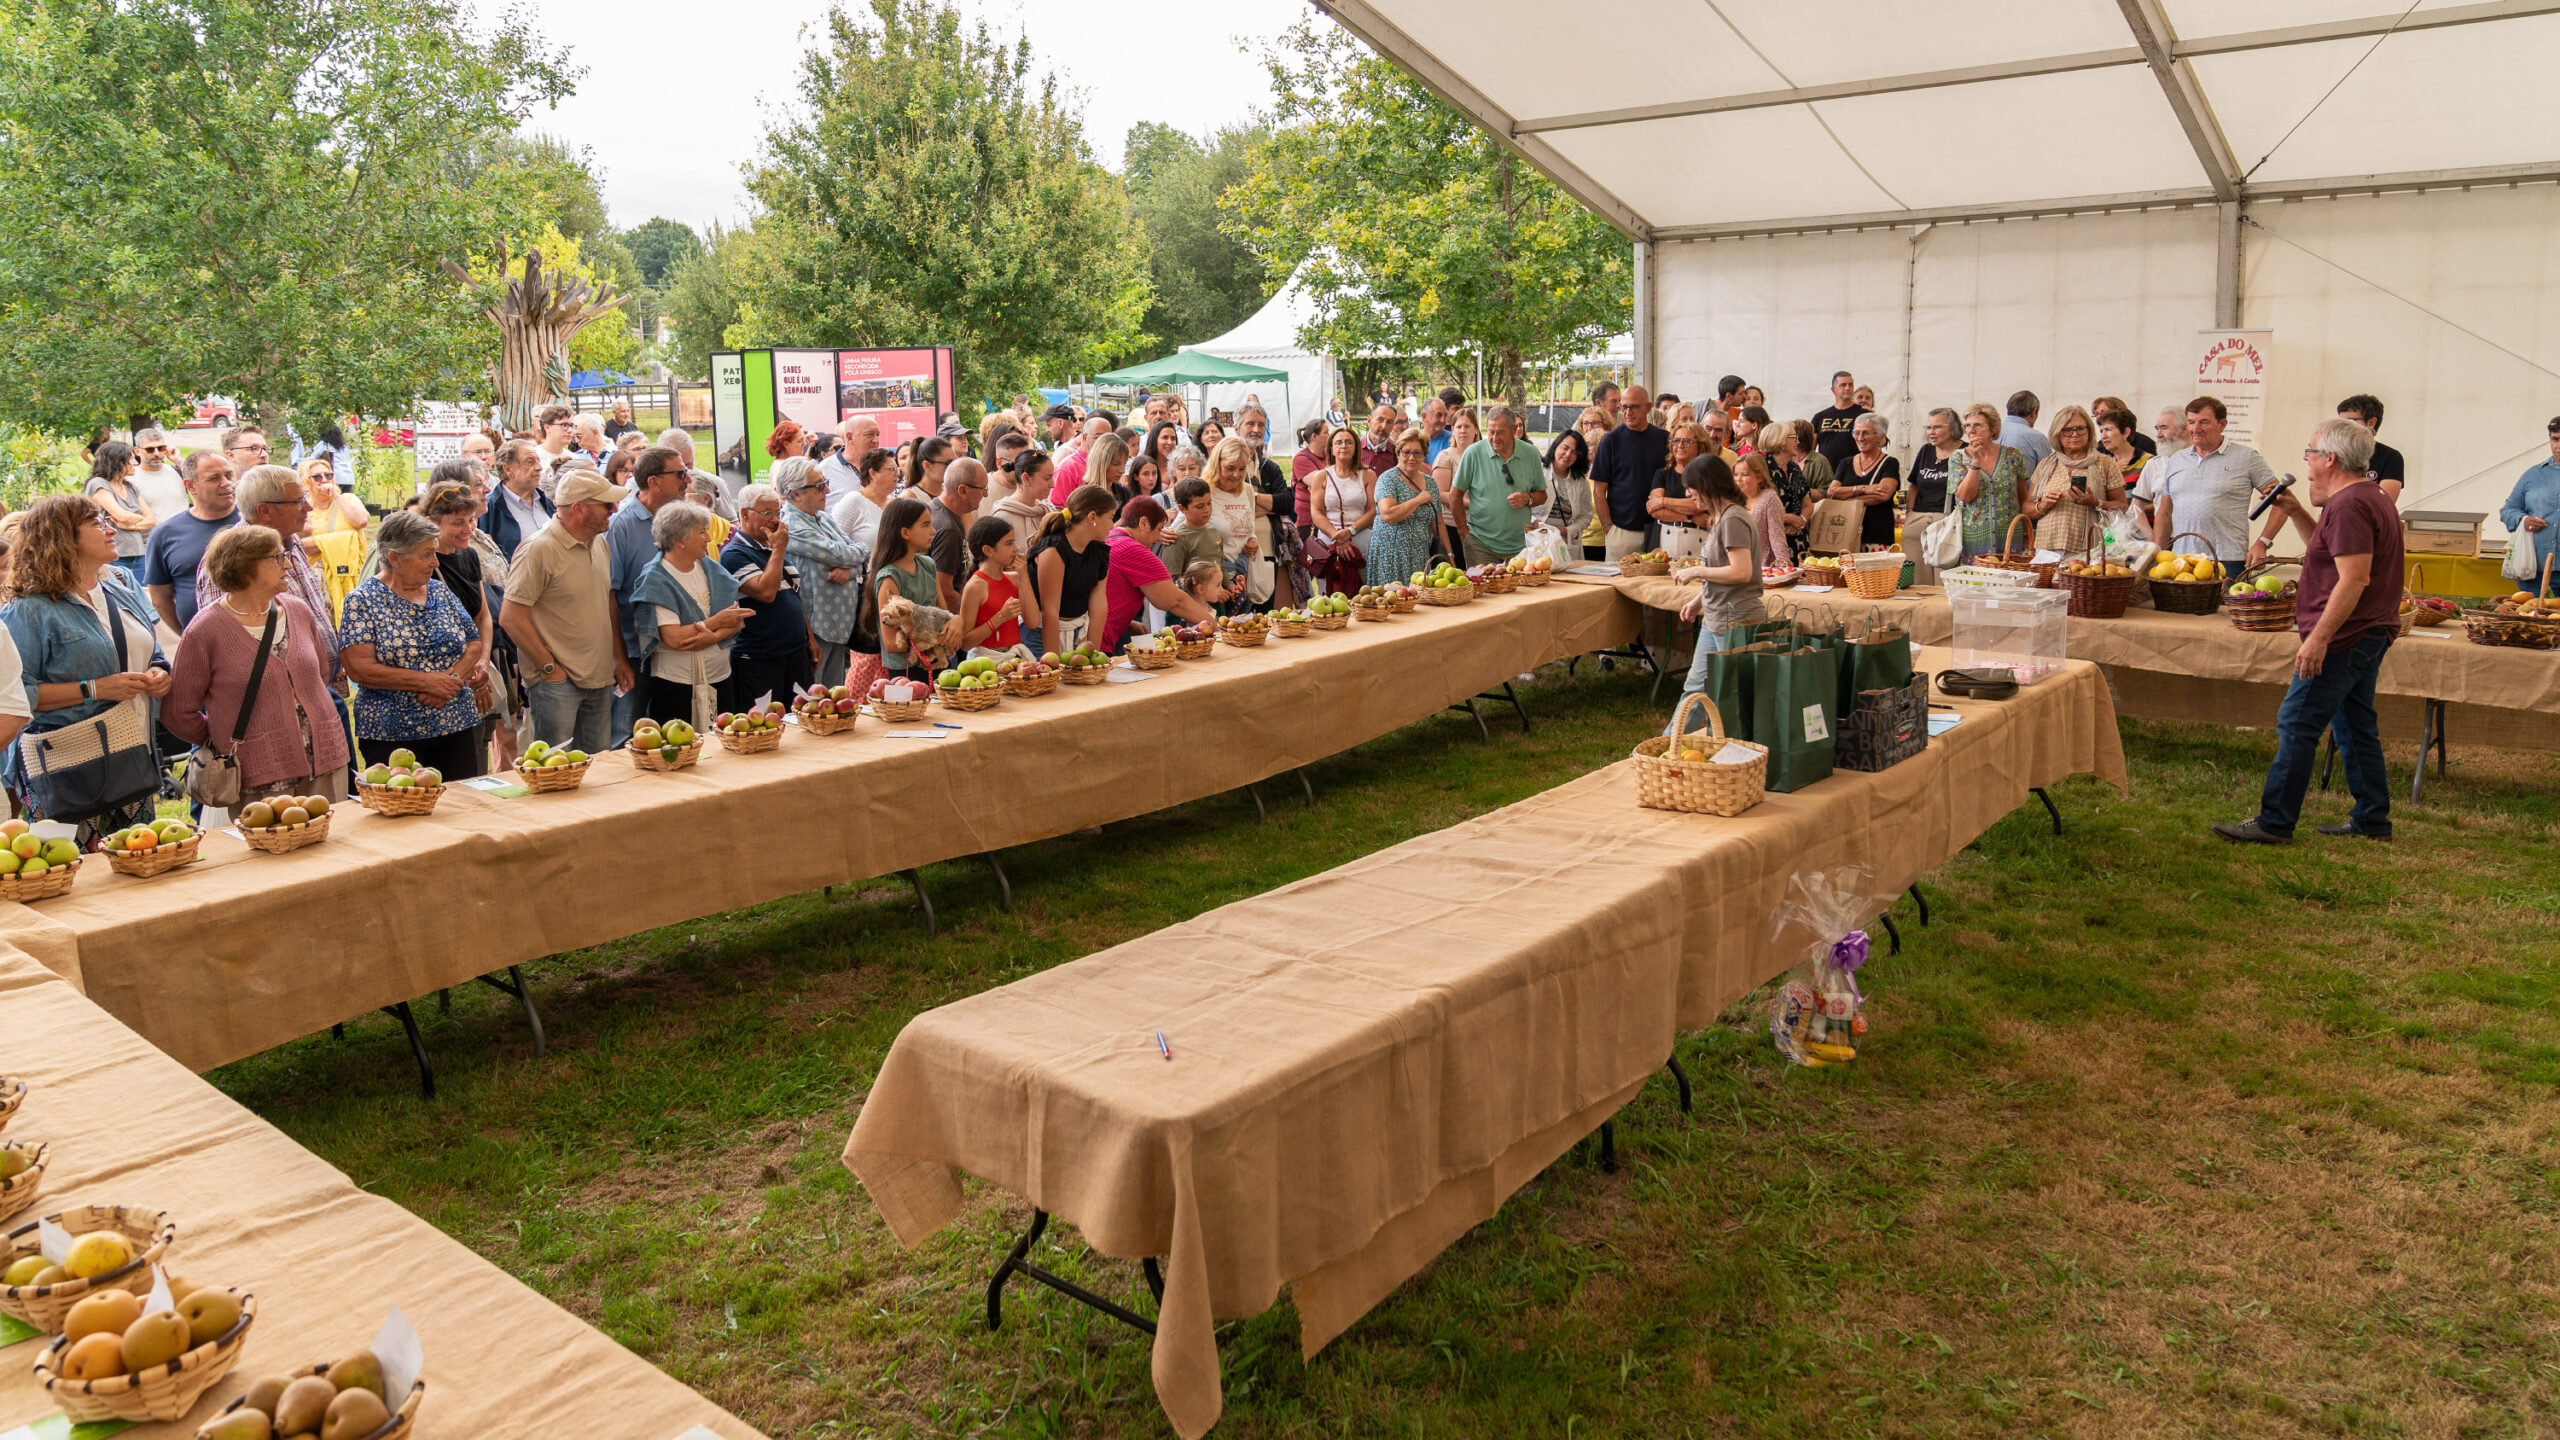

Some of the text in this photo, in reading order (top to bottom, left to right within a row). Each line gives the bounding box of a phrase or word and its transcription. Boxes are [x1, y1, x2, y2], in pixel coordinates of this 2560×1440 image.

[2199, 338, 2263, 375] CASA DO MEL
[783, 366, 801, 374] SABES
[783, 374, 810, 384] QUE É UN
[784, 386, 822, 394] XEOPARQUE?
[1821, 418, 1853, 429] EA7
